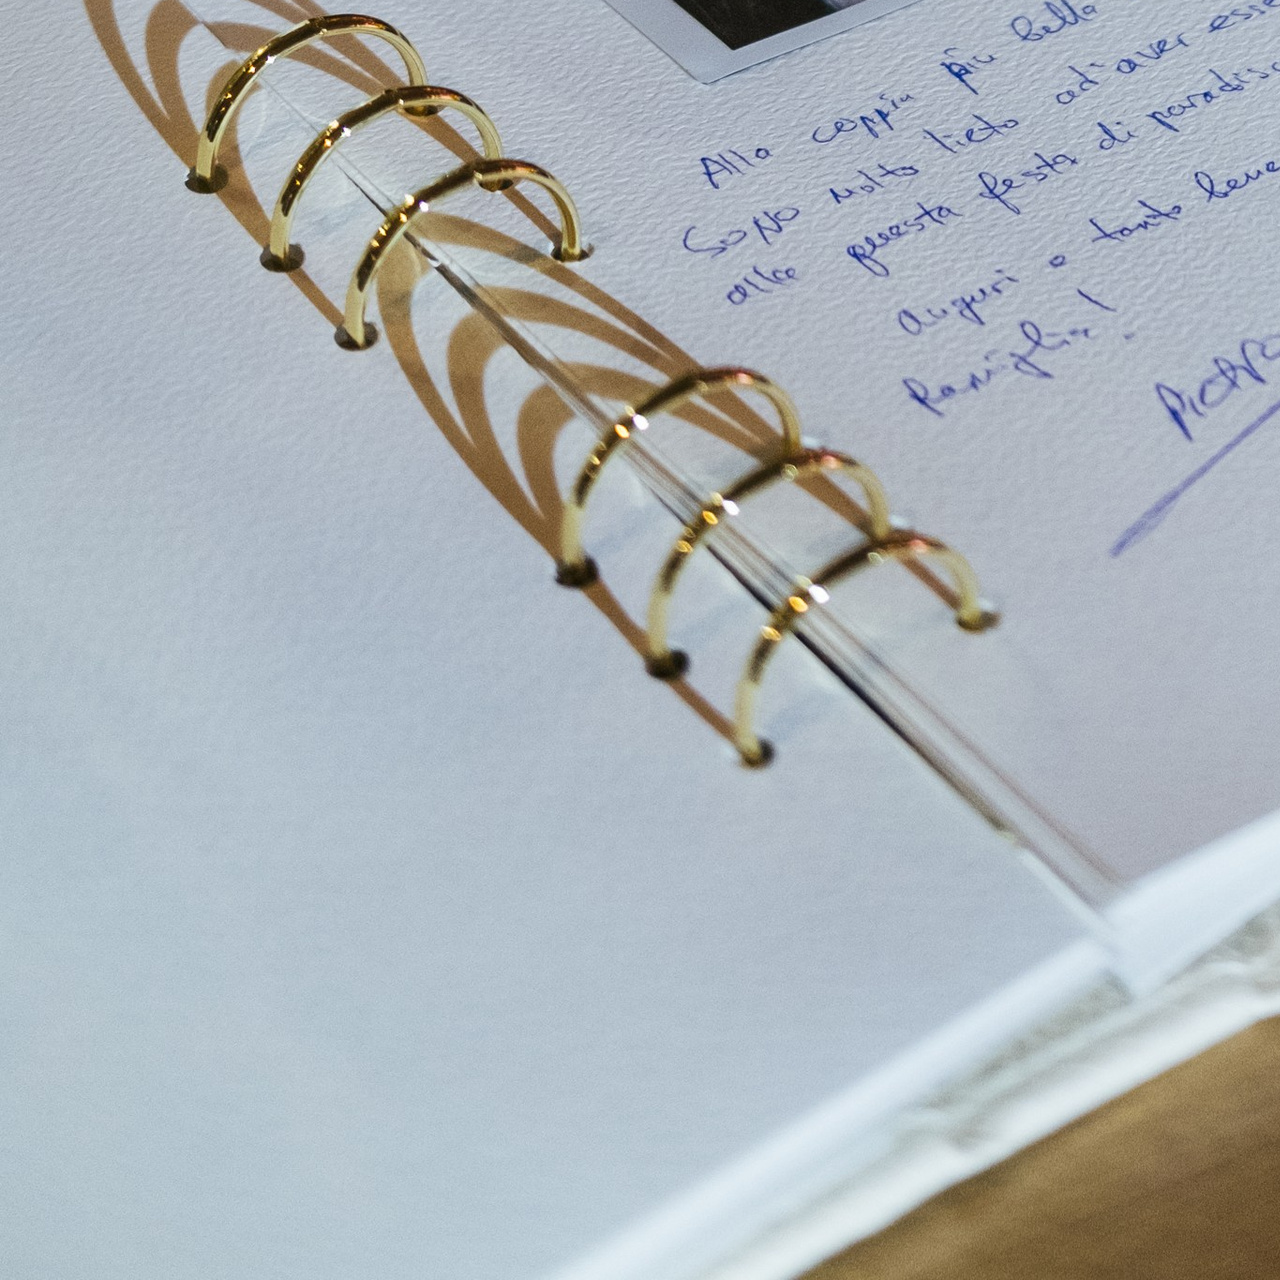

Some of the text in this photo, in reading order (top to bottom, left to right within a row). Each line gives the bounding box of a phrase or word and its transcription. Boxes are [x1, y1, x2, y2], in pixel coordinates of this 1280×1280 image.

[922, 113, 1020, 154] lieto
[699, 148, 773, 190] Alla
[845, 201, 963, 278] questa
[977, 153, 1079, 216] festa
[1097, 121, 1138, 151] di
[1088, 199, 1183, 242] tanto
